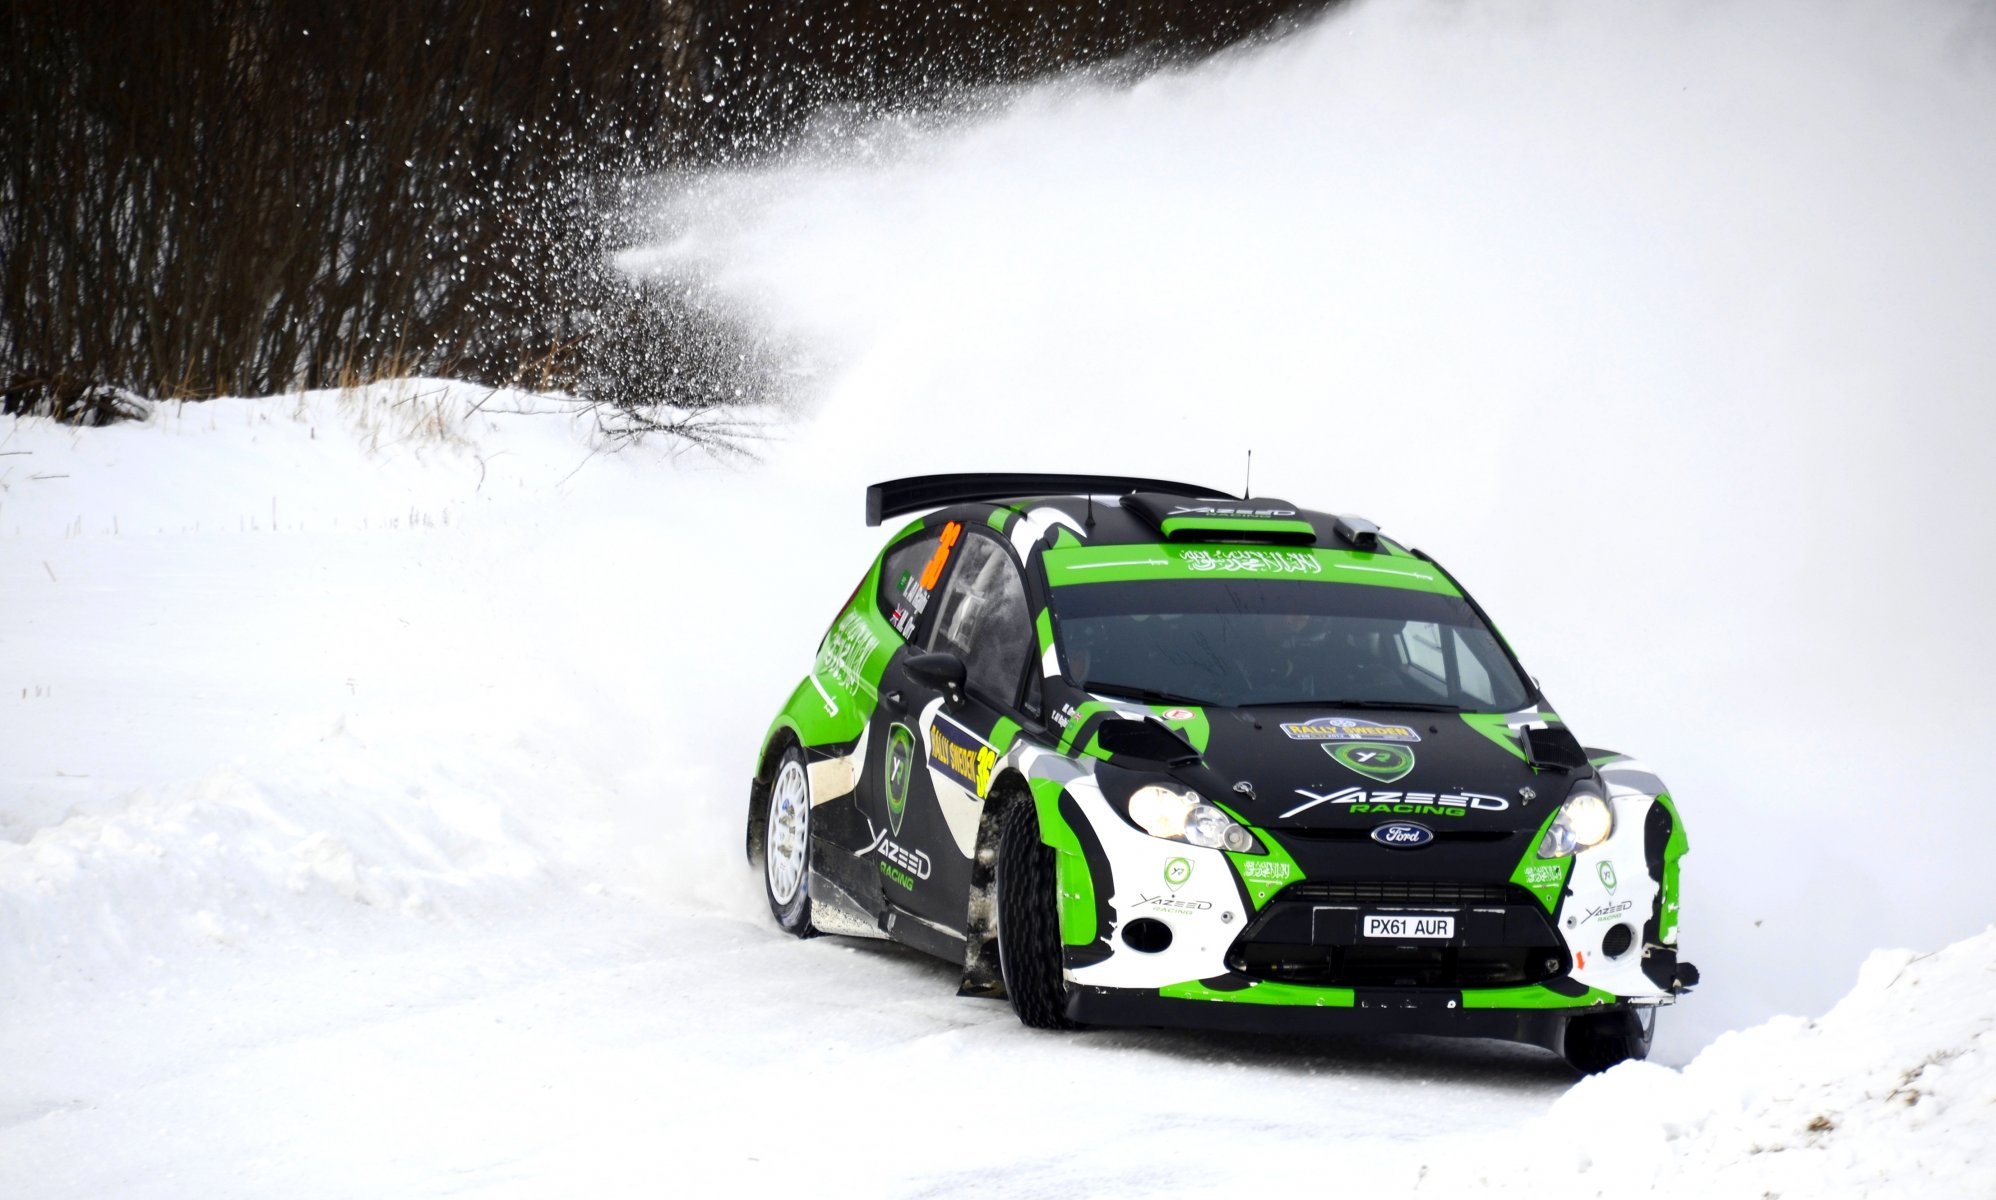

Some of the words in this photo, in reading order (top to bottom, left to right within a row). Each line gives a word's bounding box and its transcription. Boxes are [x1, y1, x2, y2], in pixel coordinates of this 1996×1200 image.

[1289, 725, 1337, 734] RALLY
[1342, 726, 1410, 736] SWEDEN
[930, 723, 949, 766] RALLY
[949, 742, 978, 784] SWEDEN
[1278, 786, 1510, 819] YAZEED
[1349, 803, 1466, 817] RACING
[1385, 826, 1420, 843] Ford
[853, 818, 932, 881] YAZEED
[879, 860, 915, 892] RACING
[1130, 893, 1213, 911] YAZEED
[1152, 906, 1194, 916] RACING
[1580, 900, 1633, 925] YAZEED
[1370, 919, 1407, 935] PX61
[1414, 920, 1448, 936] AUR
